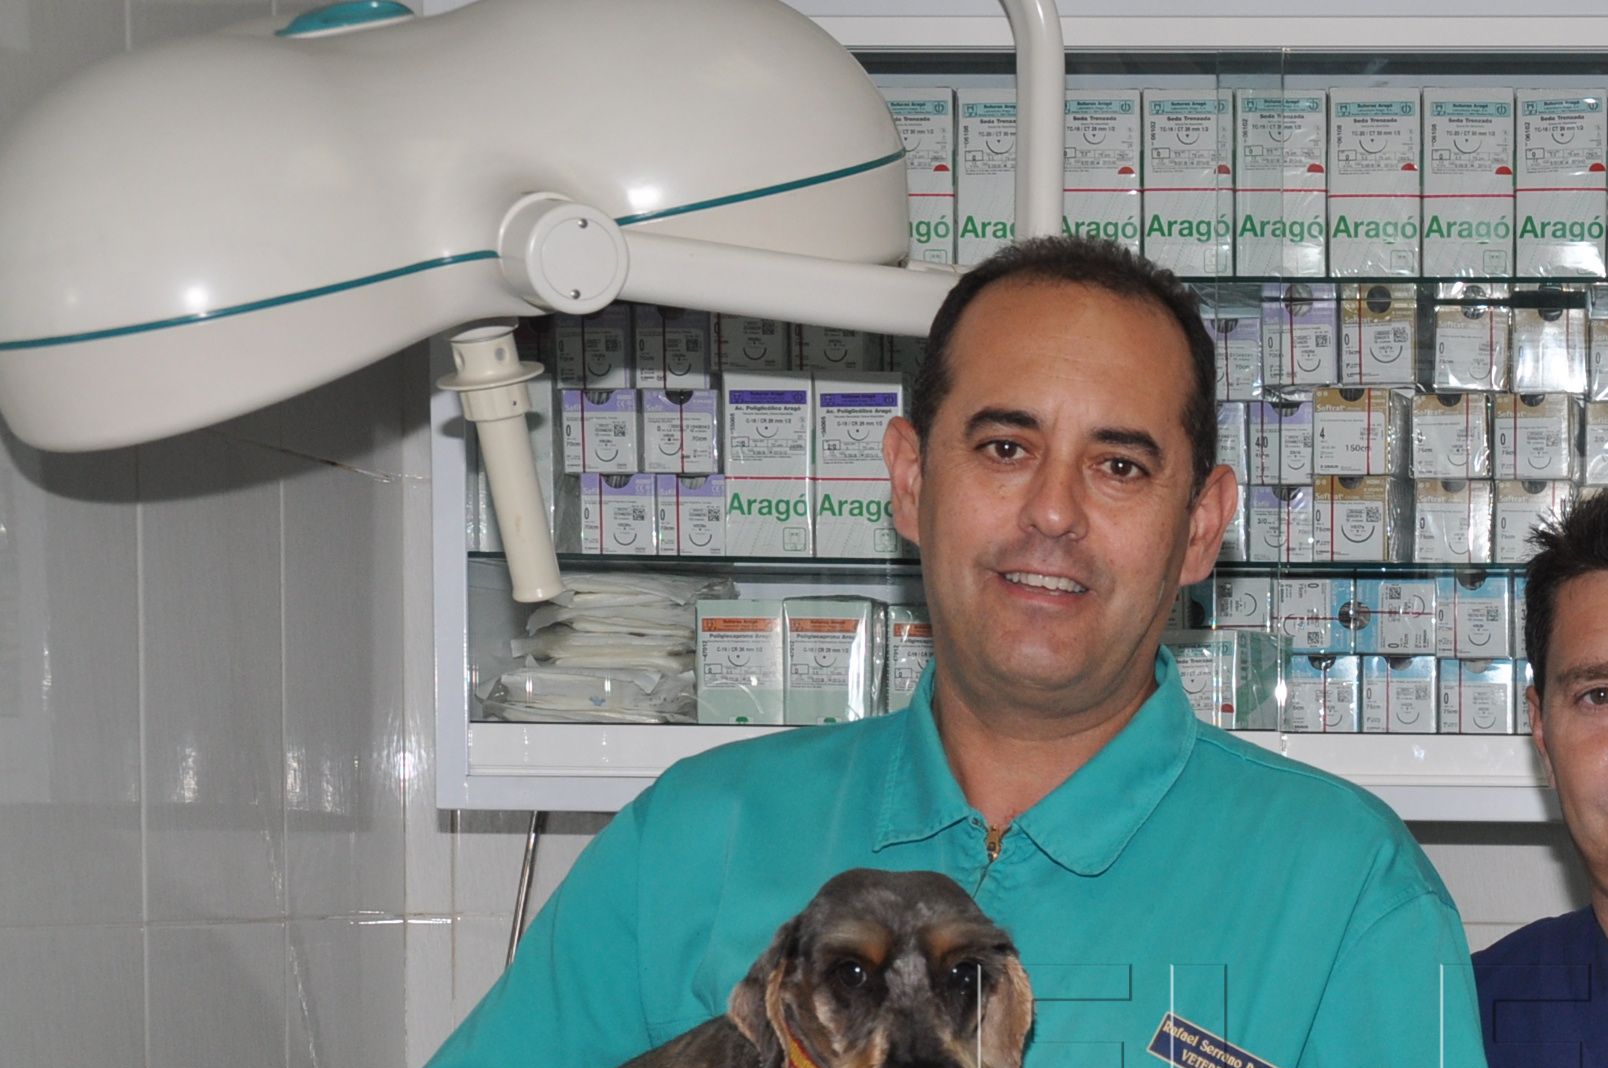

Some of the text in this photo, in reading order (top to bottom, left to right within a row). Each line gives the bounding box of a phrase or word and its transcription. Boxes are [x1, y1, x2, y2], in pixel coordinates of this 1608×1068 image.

[960, 215, 1015, 239] Ara
[1146, 214, 1231, 243] Aragó
[1238, 214, 1324, 243] Aragó
[1332, 215, 1417, 244] Aragó
[1425, 215, 1510, 244] Aragó
[1519, 215, 1604, 242] Aragó
[1320, 428, 1326, 439] 4
[727, 493, 808, 522] Aragó
[1162, 1020, 1199, 1047] Rafael
[1200, 1040, 1243, 1068] Serrano
